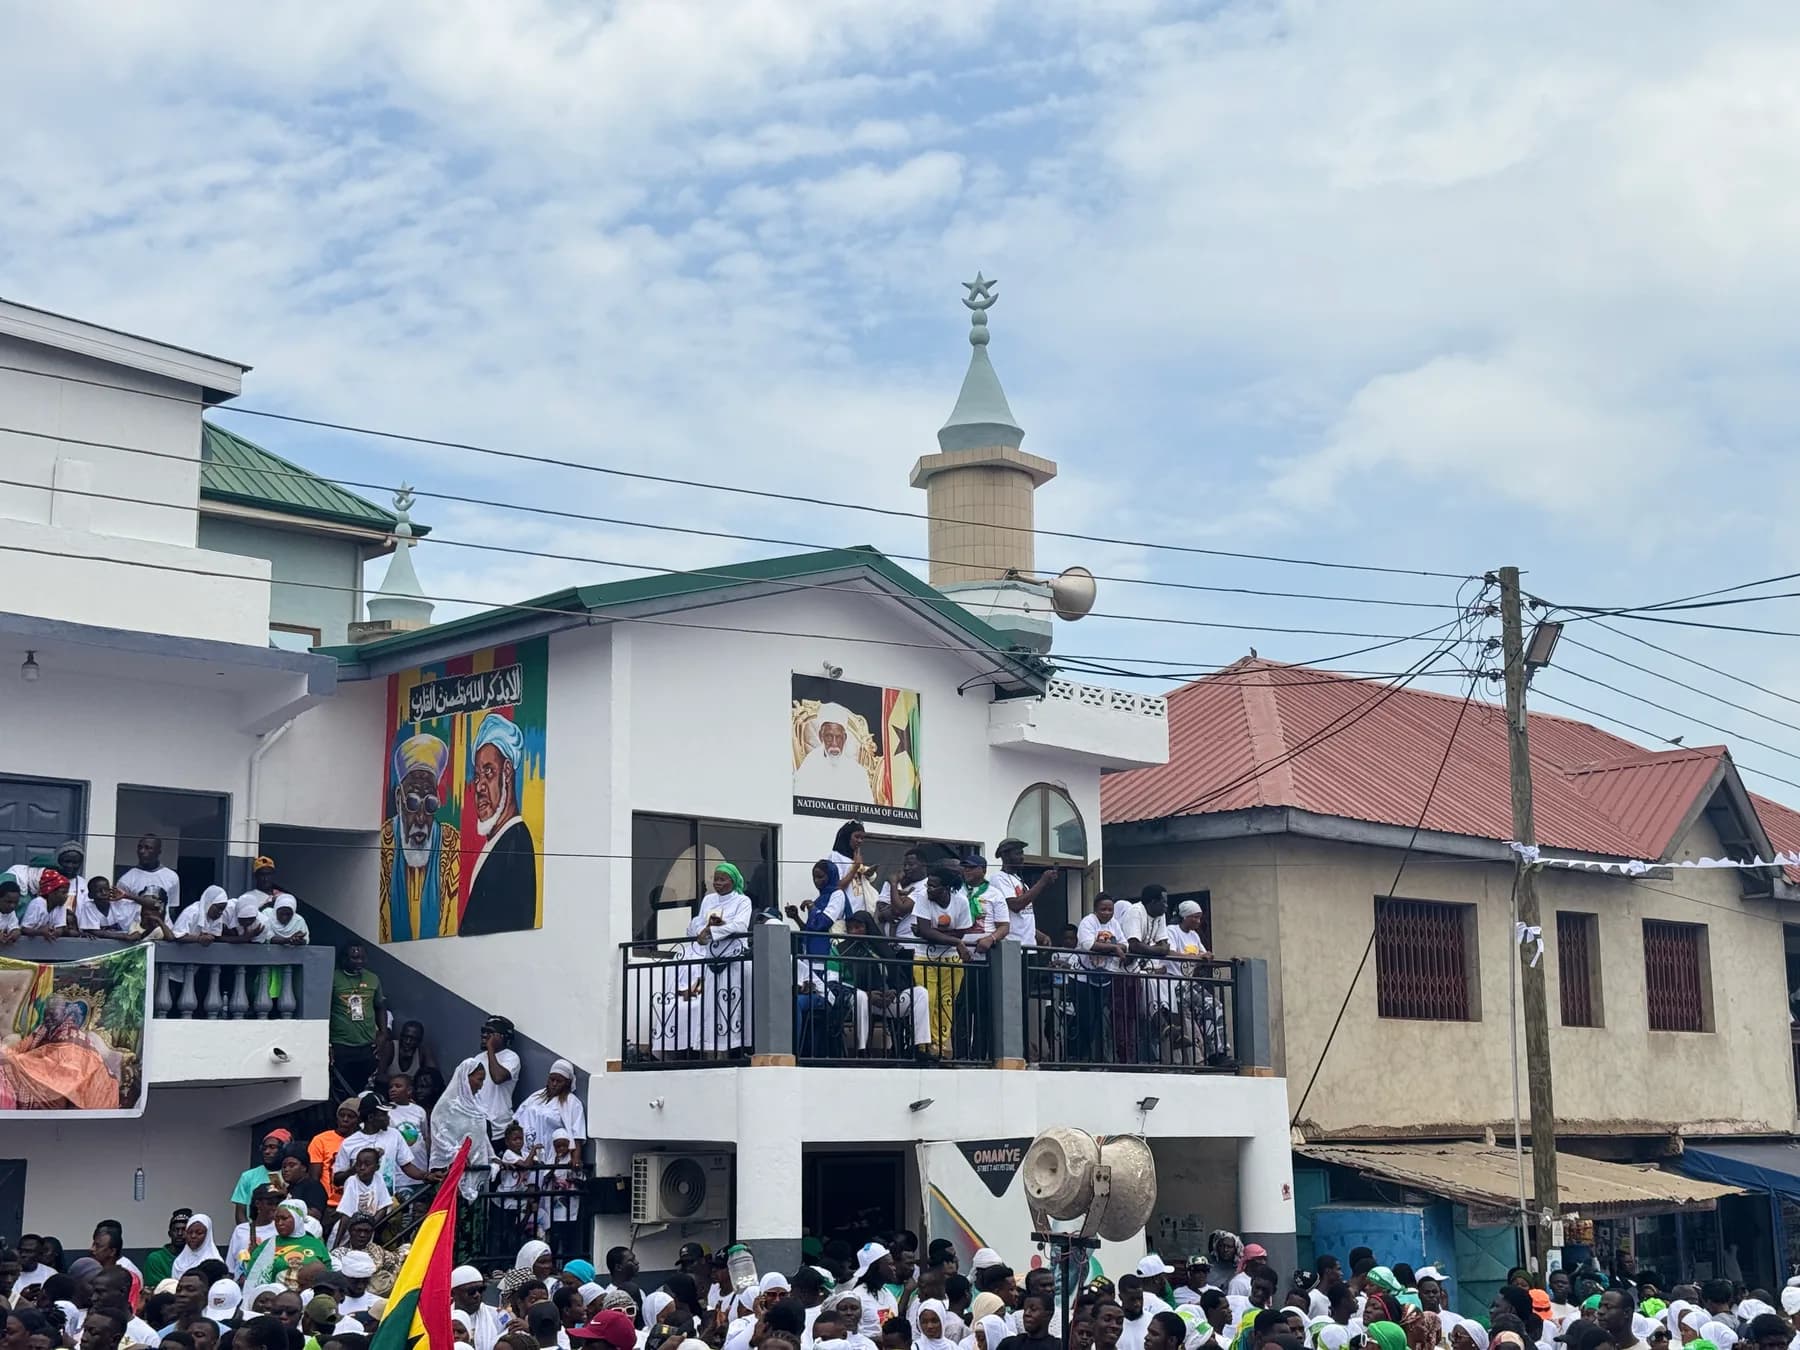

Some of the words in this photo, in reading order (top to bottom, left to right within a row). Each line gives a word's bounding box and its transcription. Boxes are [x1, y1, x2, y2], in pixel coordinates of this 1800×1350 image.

[466, 674, 485, 704] الله
[797, 800, 836, 810] NATIONAL
[836, 803, 859, 812] CHIEF
[860, 806, 881, 816] IMAM
[881, 808, 892, 817] OF
[892, 811, 919, 821] GHANA
[974, 1149, 1021, 1163] OMANYE
